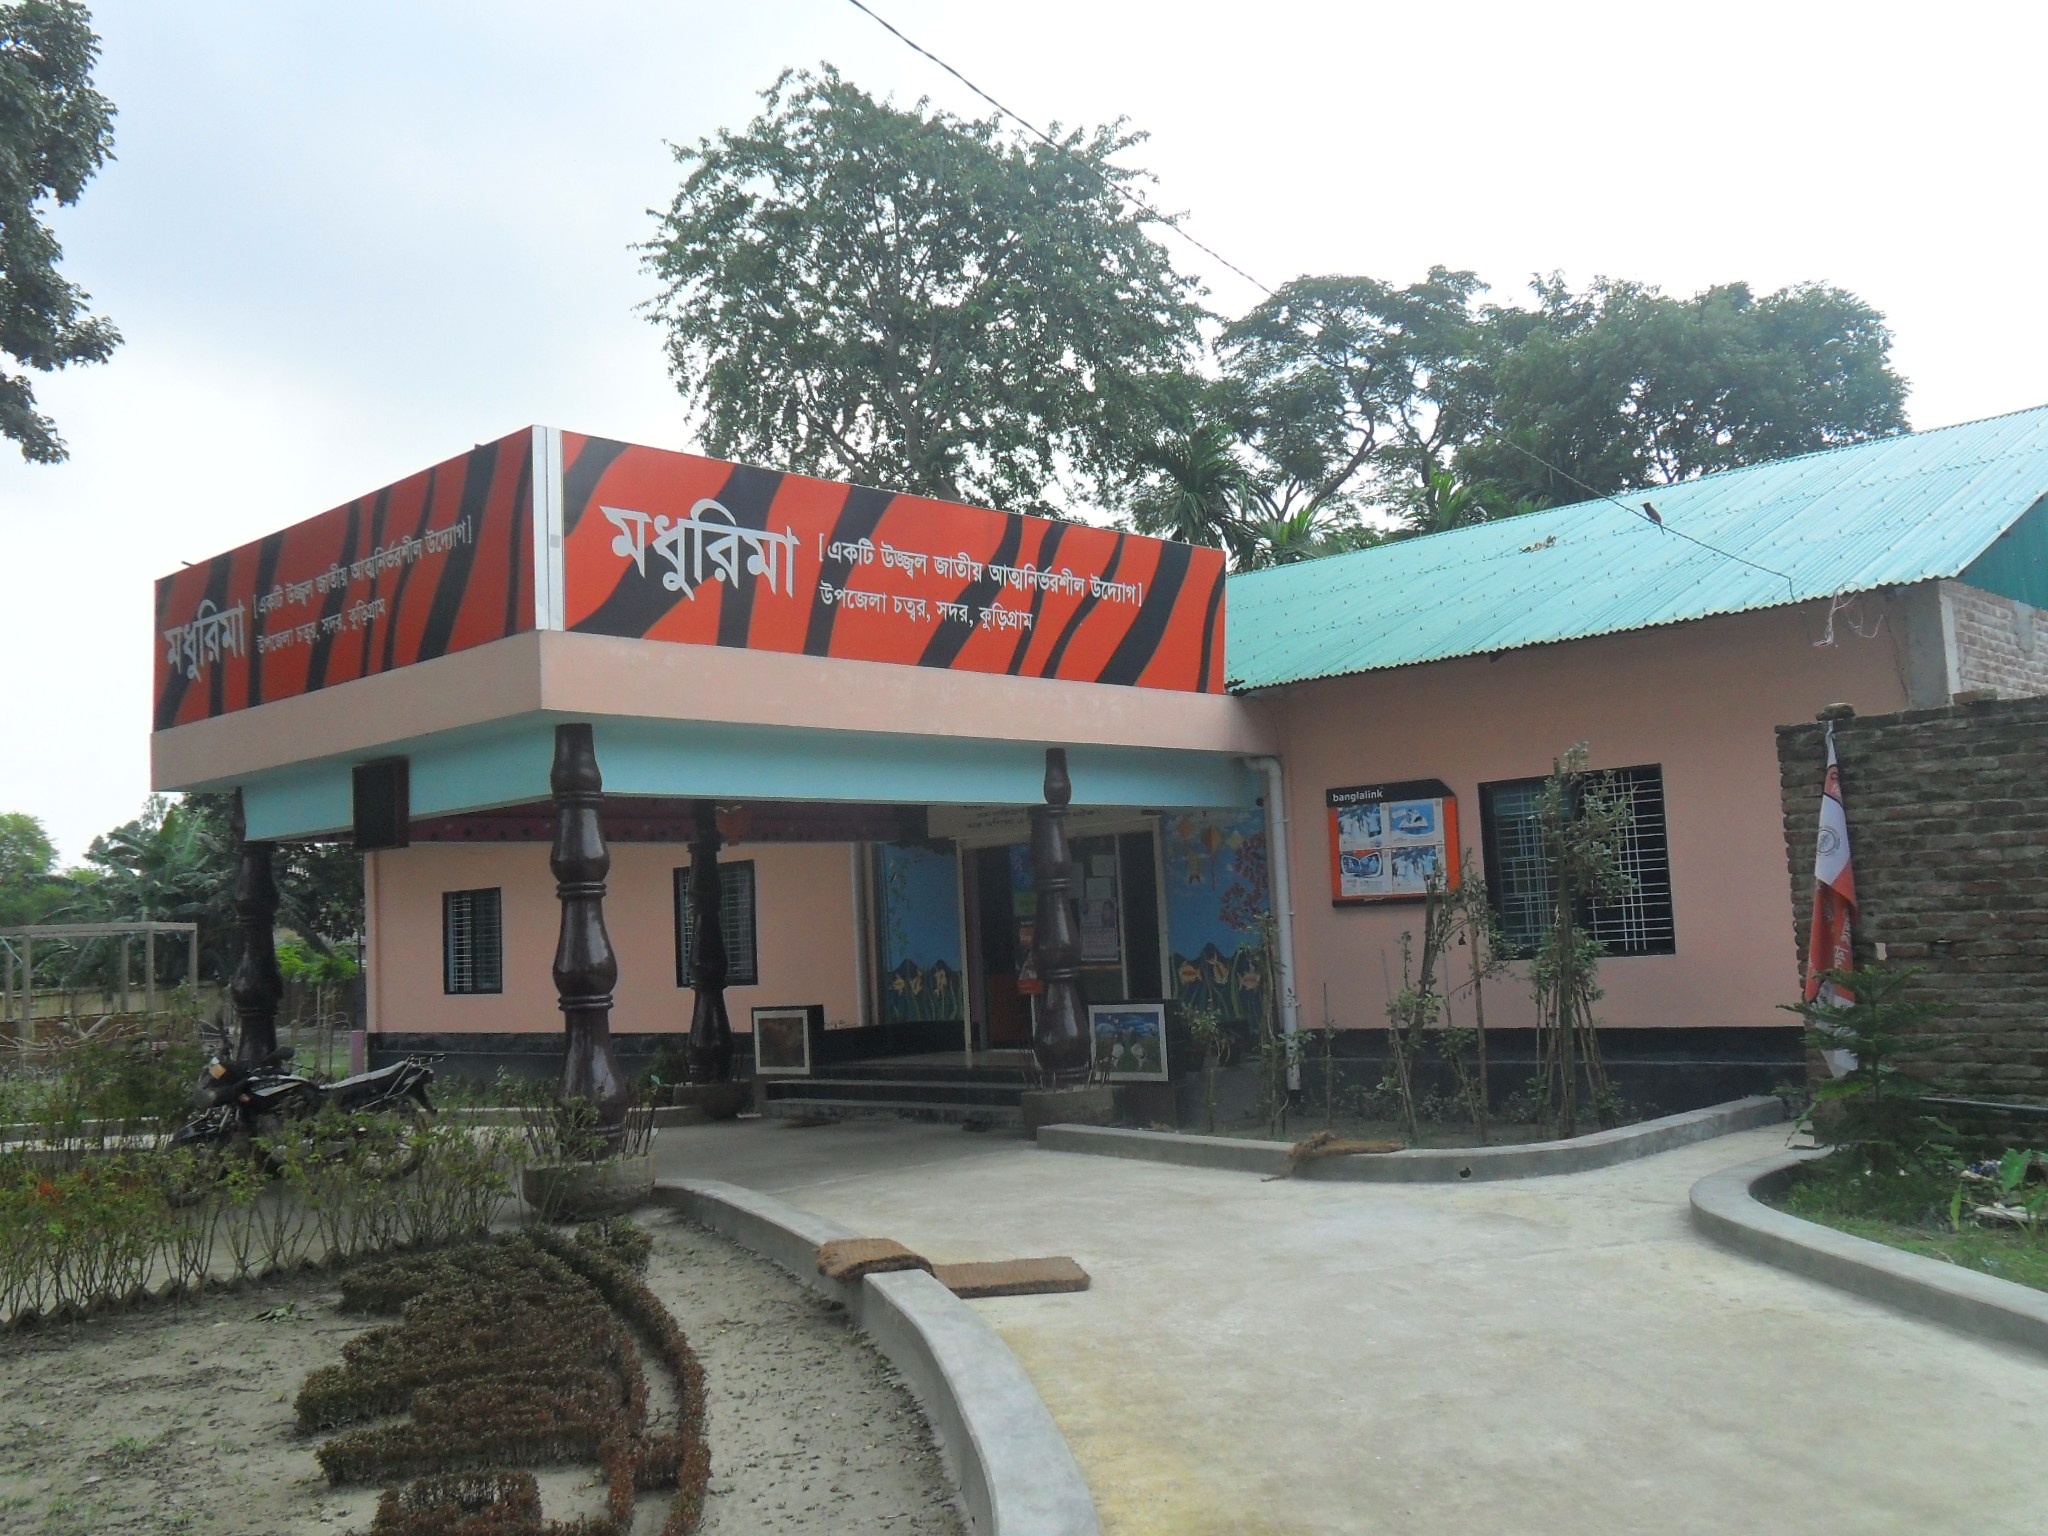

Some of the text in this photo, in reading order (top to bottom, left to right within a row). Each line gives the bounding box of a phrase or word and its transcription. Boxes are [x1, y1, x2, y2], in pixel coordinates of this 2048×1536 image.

[315, 563, 348, 594] জাতীয়
[349, 535, 422, 581] আত্মনির্ভরশীল
[599, 498, 801, 601] মধুরিমা
[880, 543, 928, 580] উজ্জ্বল
[934, 550, 983, 584] জাতীয়
[988, 562, 1085, 599] আত্মনির্ভরশীল
[819, 579, 1034, 632] উপজেলা চত্বর, সদর, কুড়িগ্রাম
[163, 598, 246, 682] মধুরিমা
[1332, 788, 1384, 803] banglalink
